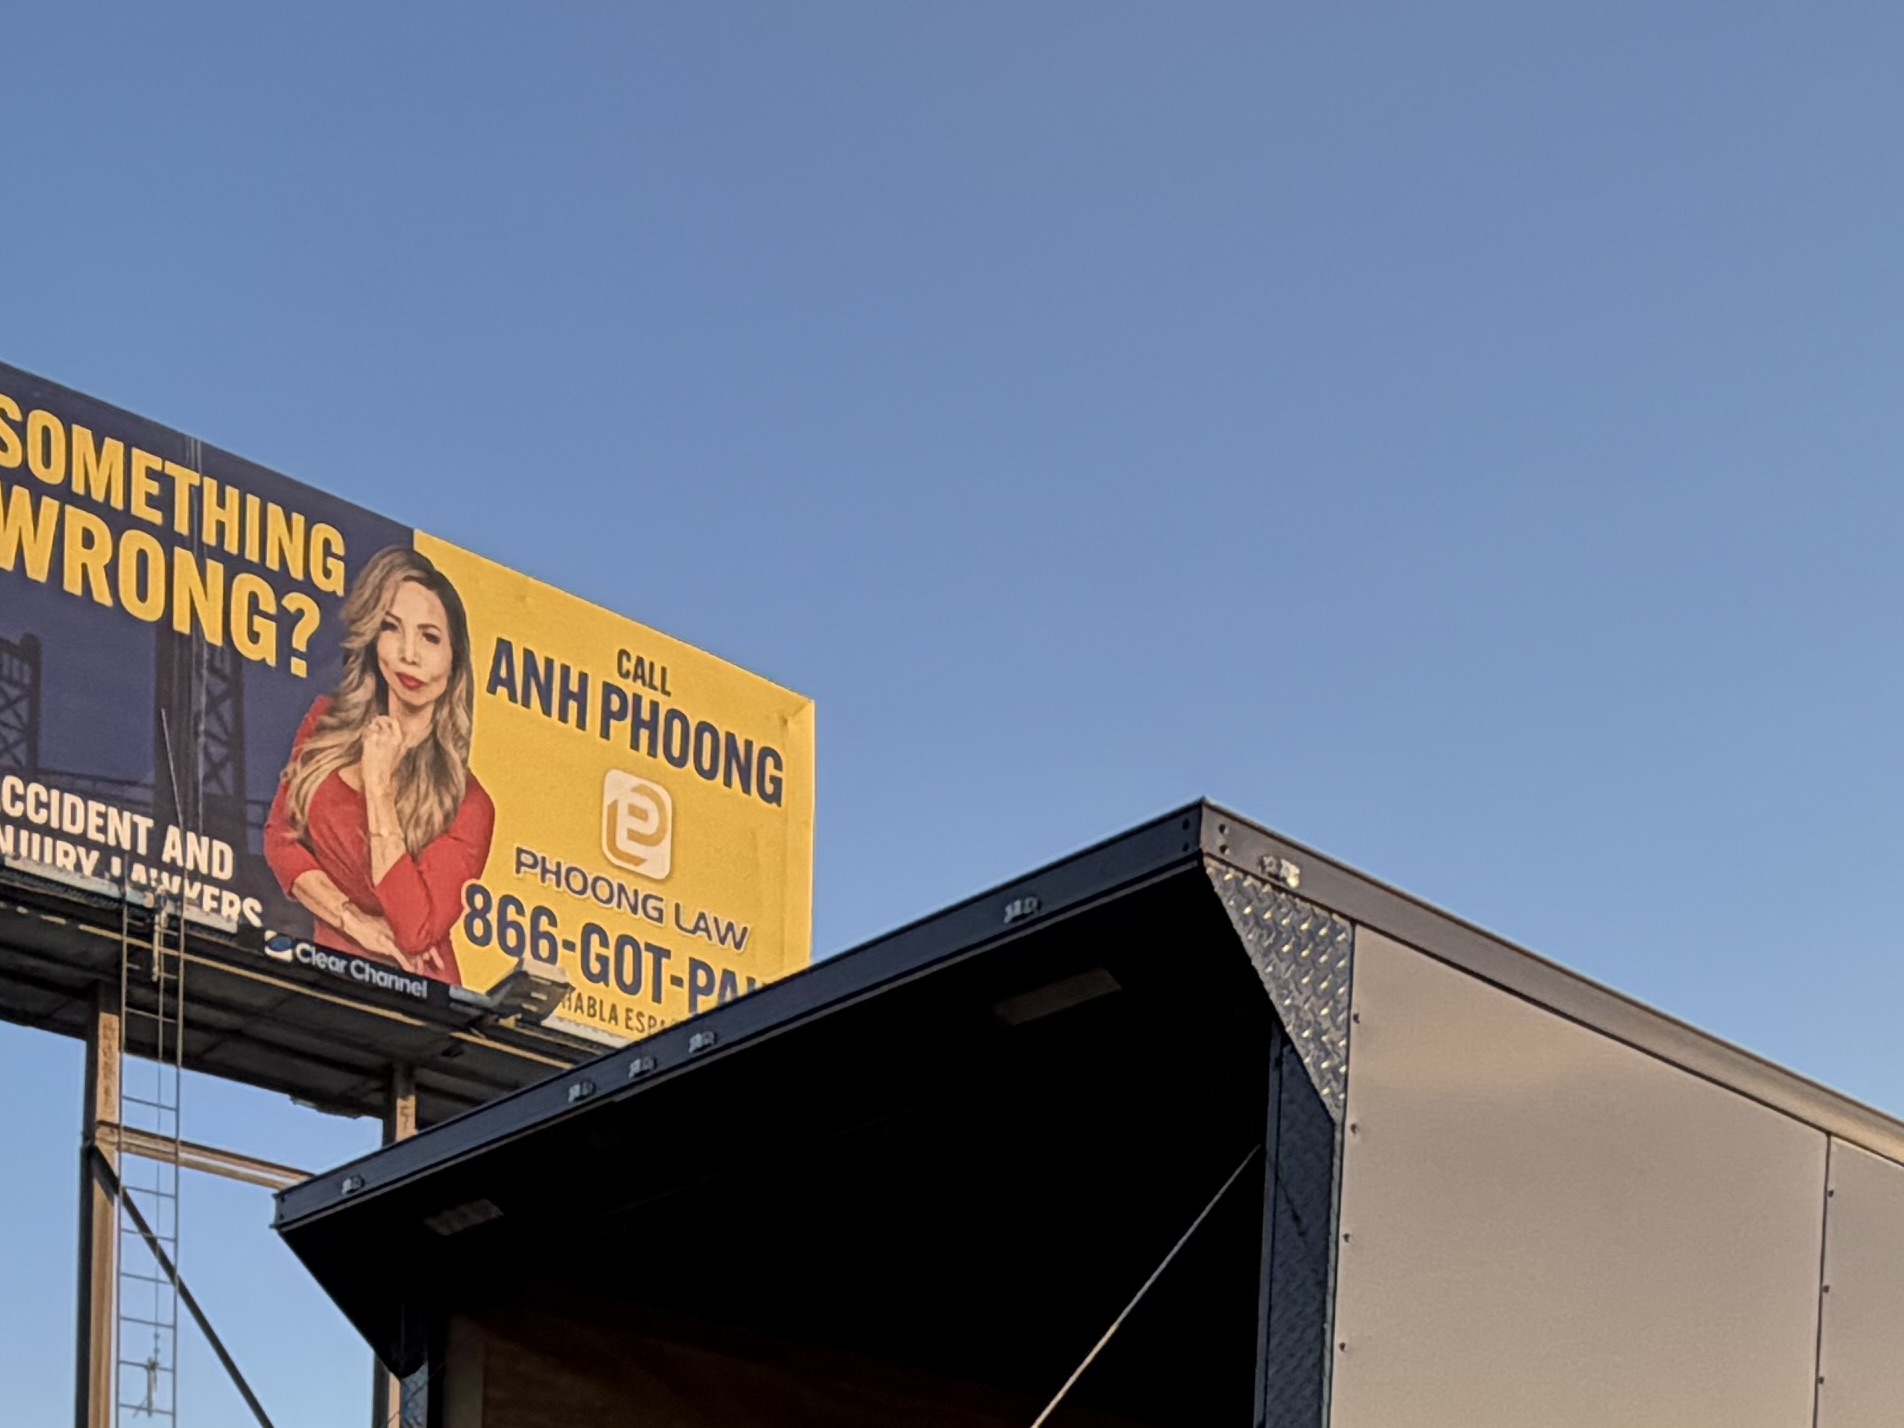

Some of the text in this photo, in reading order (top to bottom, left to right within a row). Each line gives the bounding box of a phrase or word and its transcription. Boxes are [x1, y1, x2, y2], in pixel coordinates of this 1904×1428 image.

[617, 648, 672, 697] CALL
[486, 637, 784, 807] ANH PHOONG
[161, 824, 234, 880] AND
[514, 846, 749, 951] PHOONG LAW
[296, 942, 428, 999] Clear Channel
